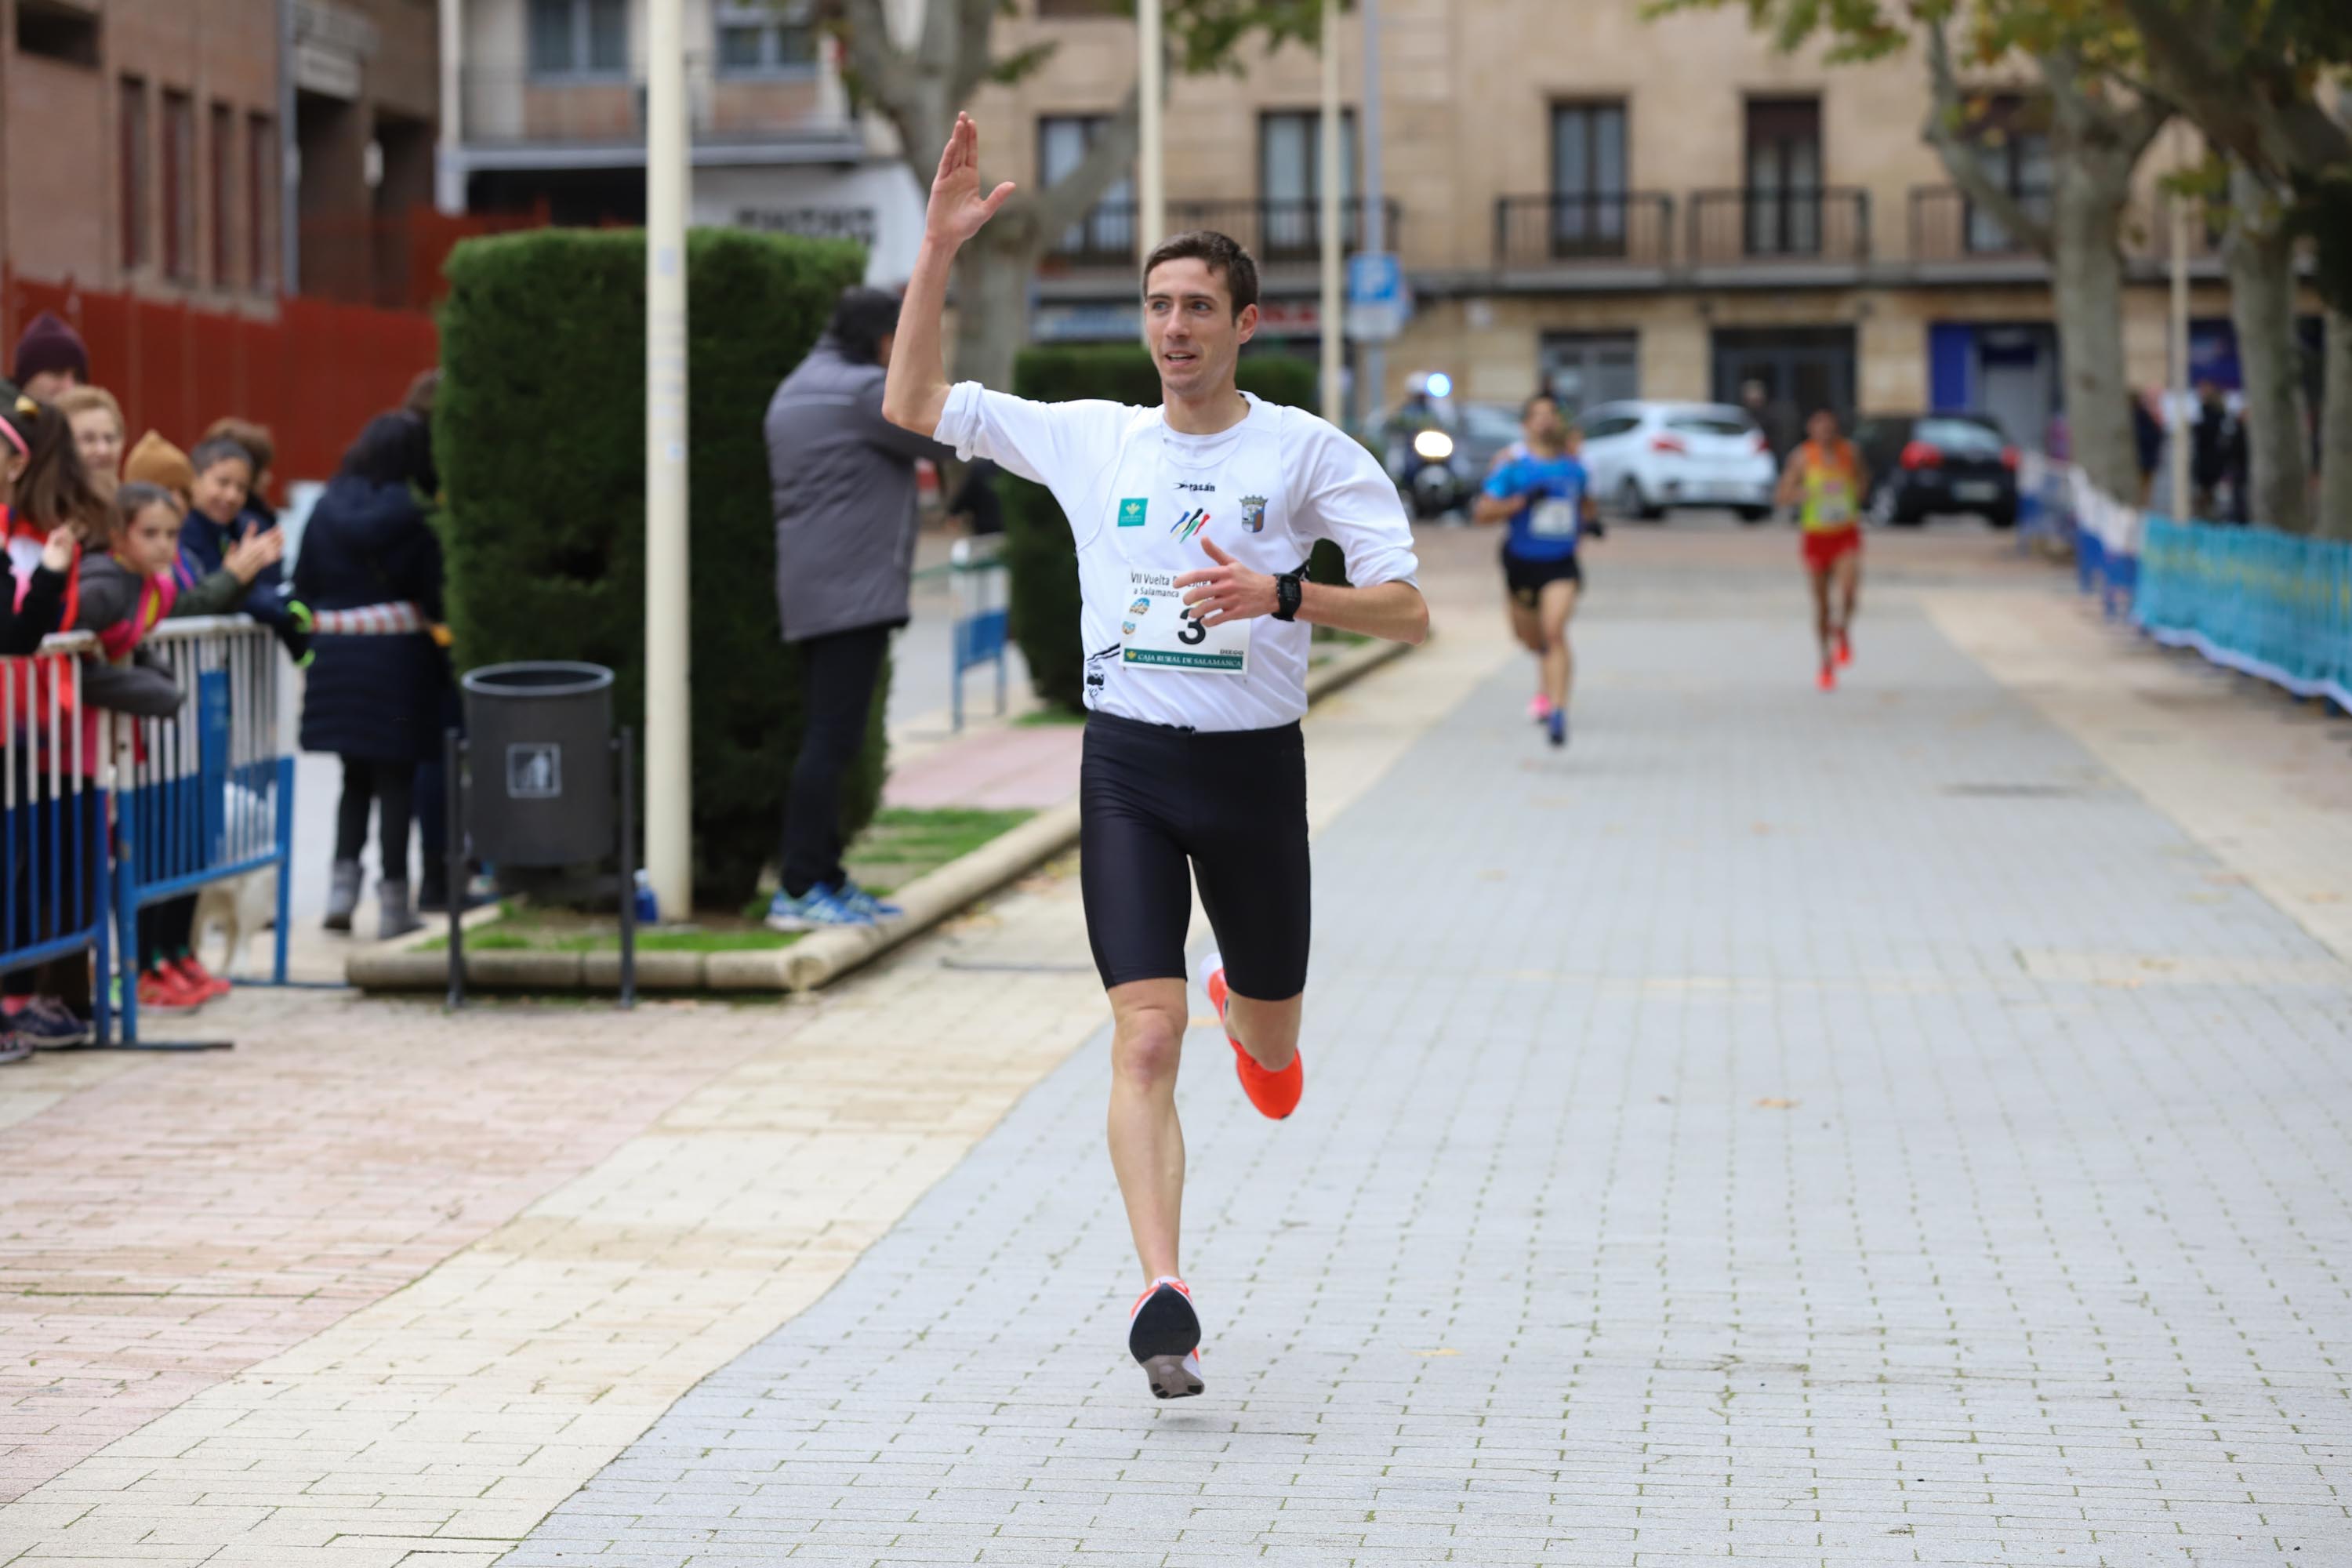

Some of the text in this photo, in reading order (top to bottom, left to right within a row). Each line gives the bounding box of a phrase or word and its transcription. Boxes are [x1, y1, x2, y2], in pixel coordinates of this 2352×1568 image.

[1131, 572, 1142, 583] VII
[1144, 573, 1170, 586] Vuelta
[1141, 587, 1179, 597] Salamanca
[1178, 608, 1206, 644] 3
[1194, 657, 1242, 666] SALAMANCA
